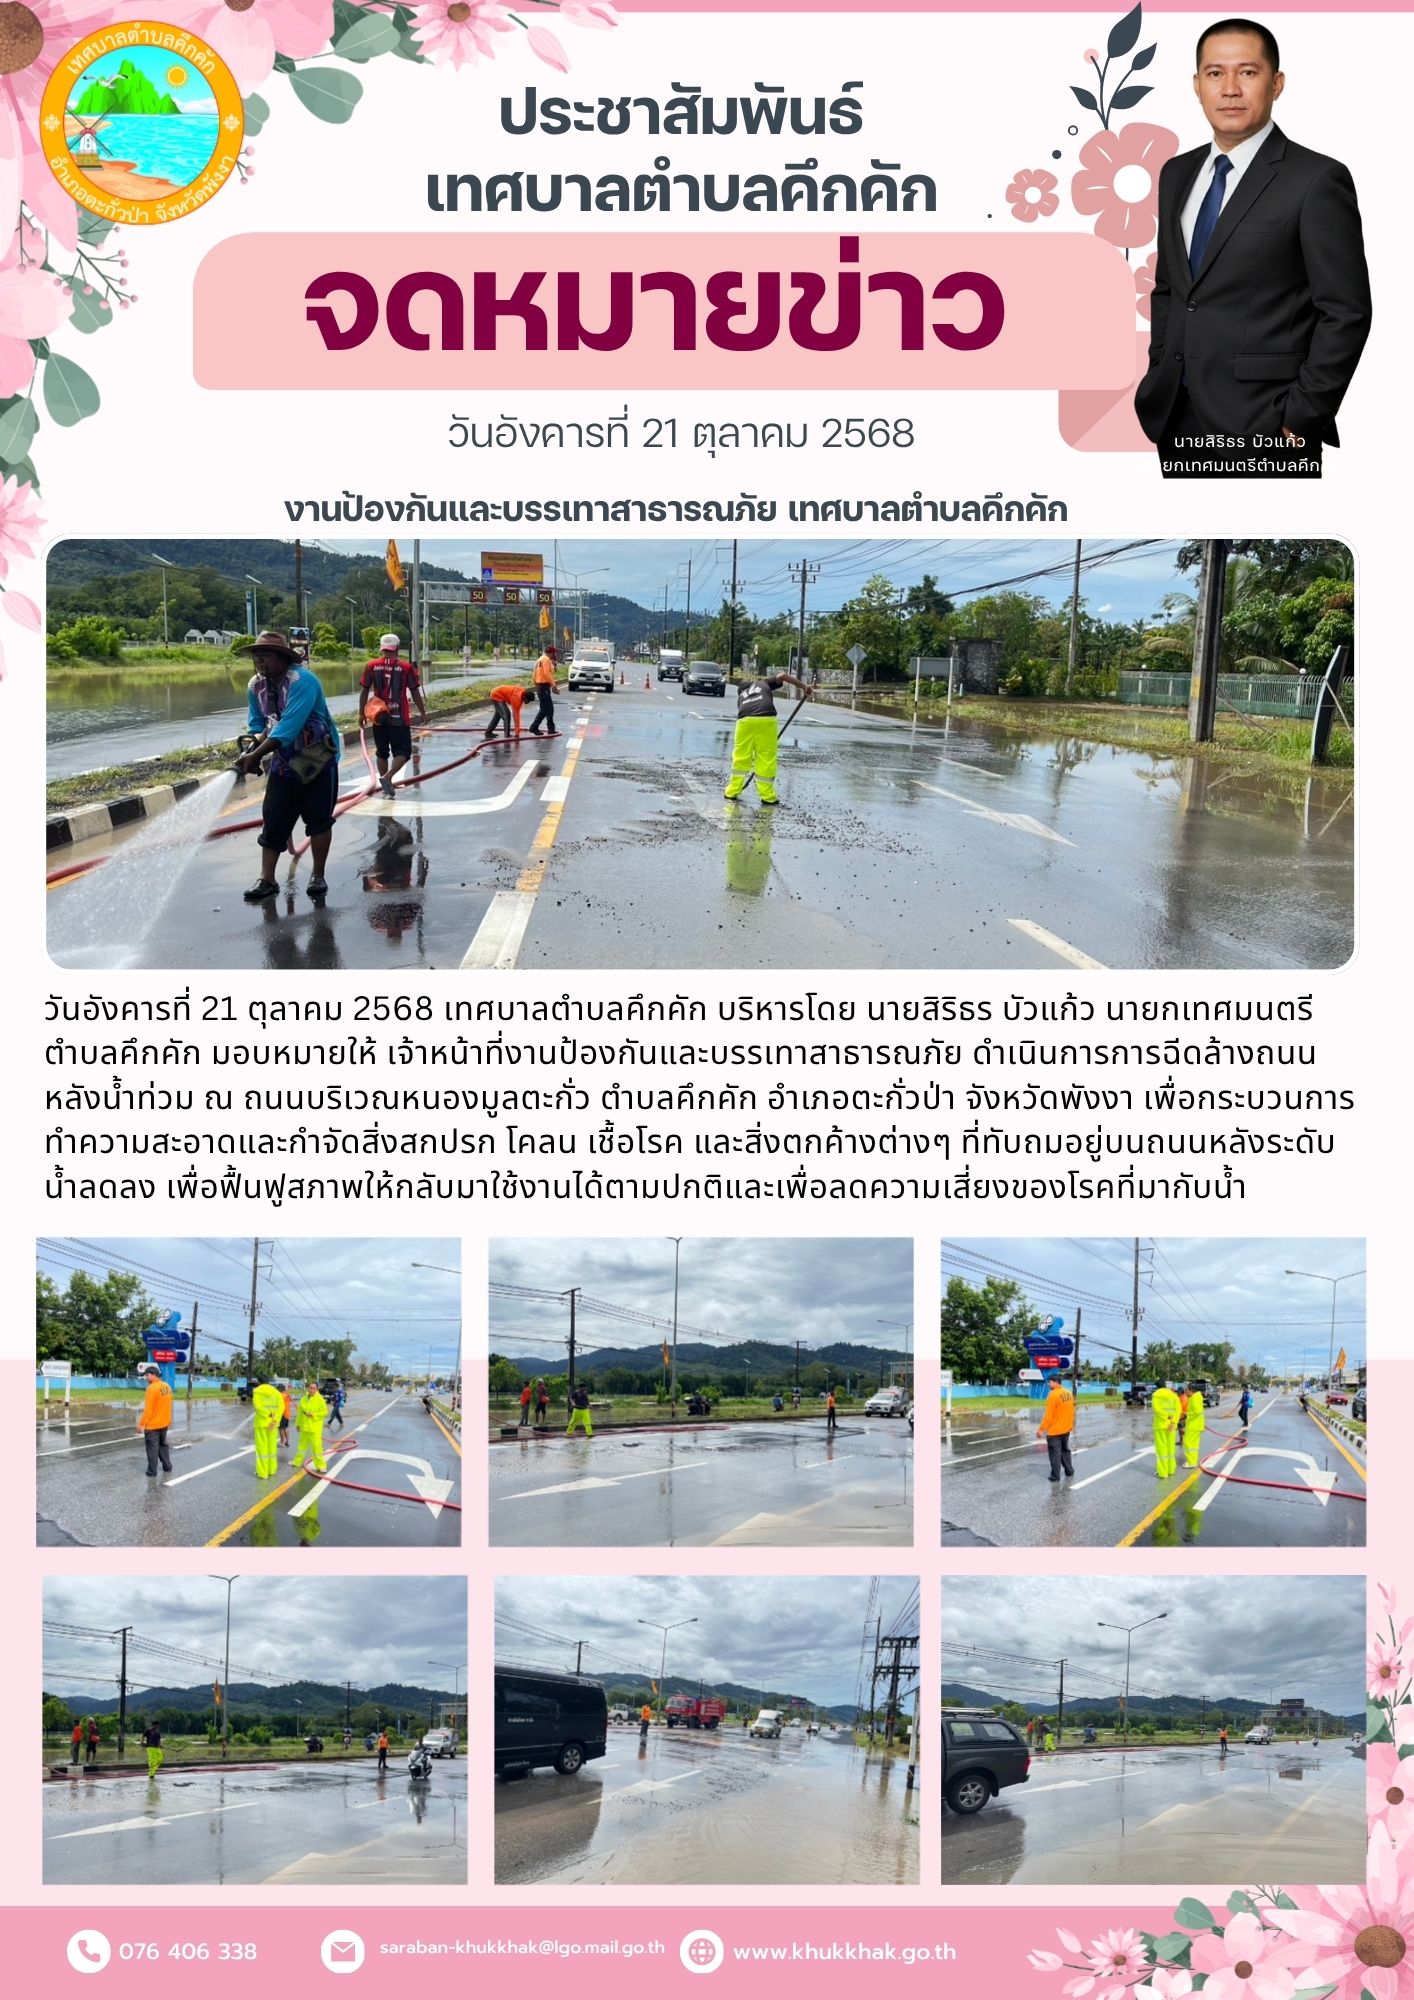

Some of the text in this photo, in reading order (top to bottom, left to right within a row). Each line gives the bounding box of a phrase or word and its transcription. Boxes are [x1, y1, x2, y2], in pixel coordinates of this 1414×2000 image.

[66, 22, 217, 75] เทศบาลตำบลคึกคัก
[472, 591, 484, 600] 50
[506, 592, 517, 601] 50
[539, 594, 550, 603] 50
